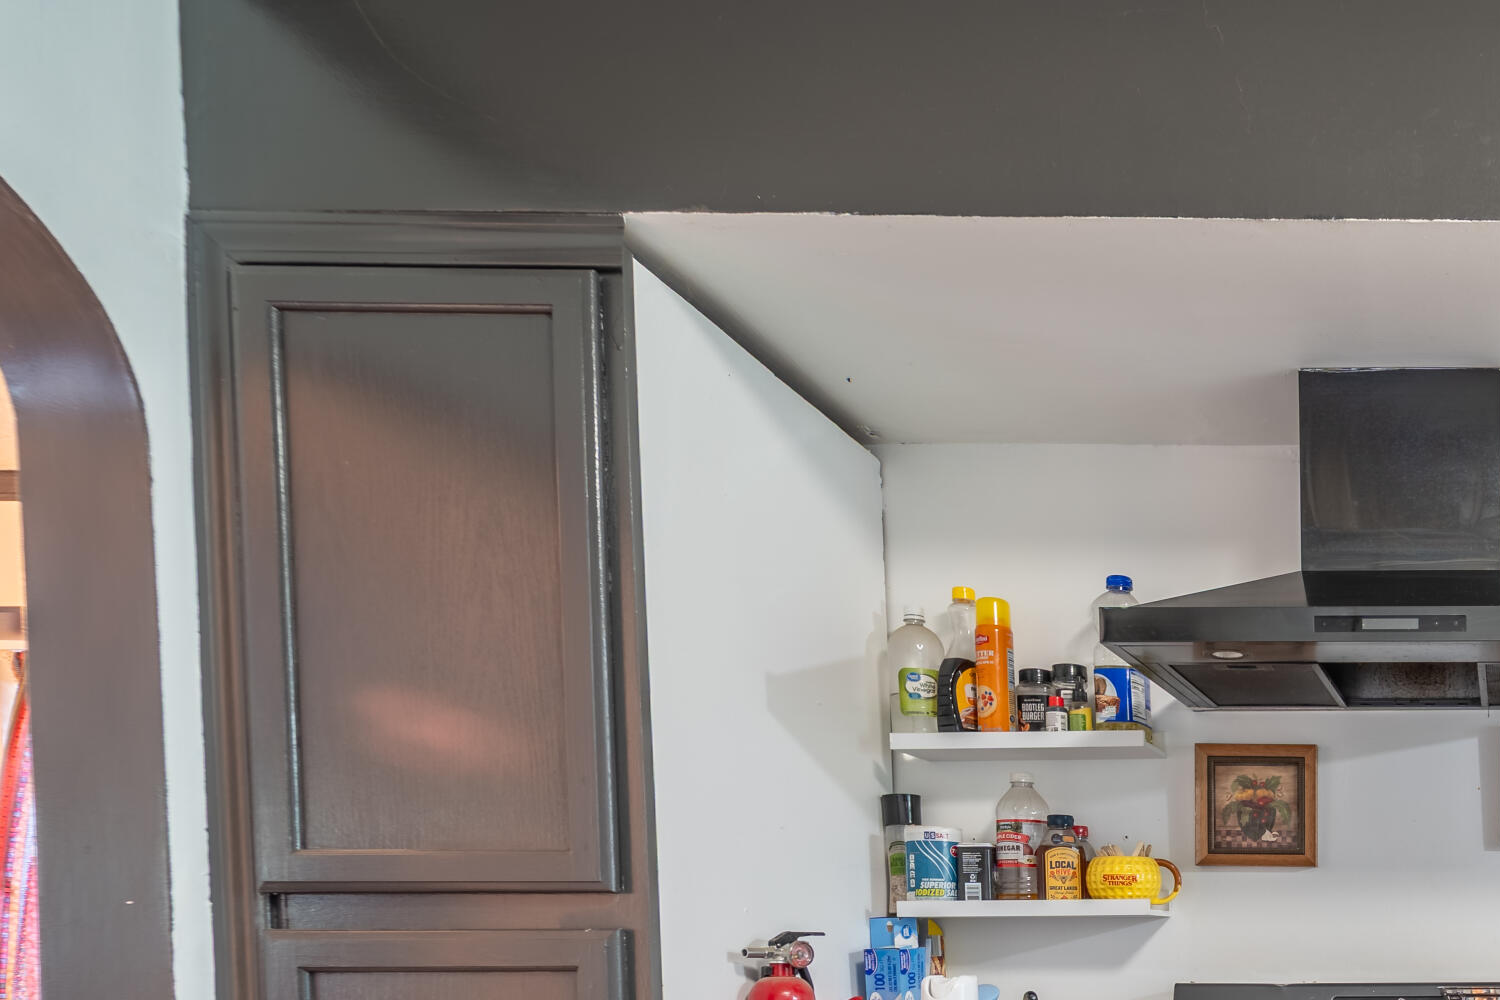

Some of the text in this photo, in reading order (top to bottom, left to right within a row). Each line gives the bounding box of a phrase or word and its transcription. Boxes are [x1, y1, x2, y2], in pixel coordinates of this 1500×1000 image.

[1021, 703, 1045, 712] BOOTLEG
[1022, 711, 1045, 721] BURGER
[1049, 860, 1077, 870] LOCAL
[1102, 873, 1137, 882] STRANGER
[920, 881, 956, 889] SUPERIOR
[915, 888, 957, 897] IODIZED SAL
[874, 973, 885, 991] 100
[908, 971, 916, 990] 100
